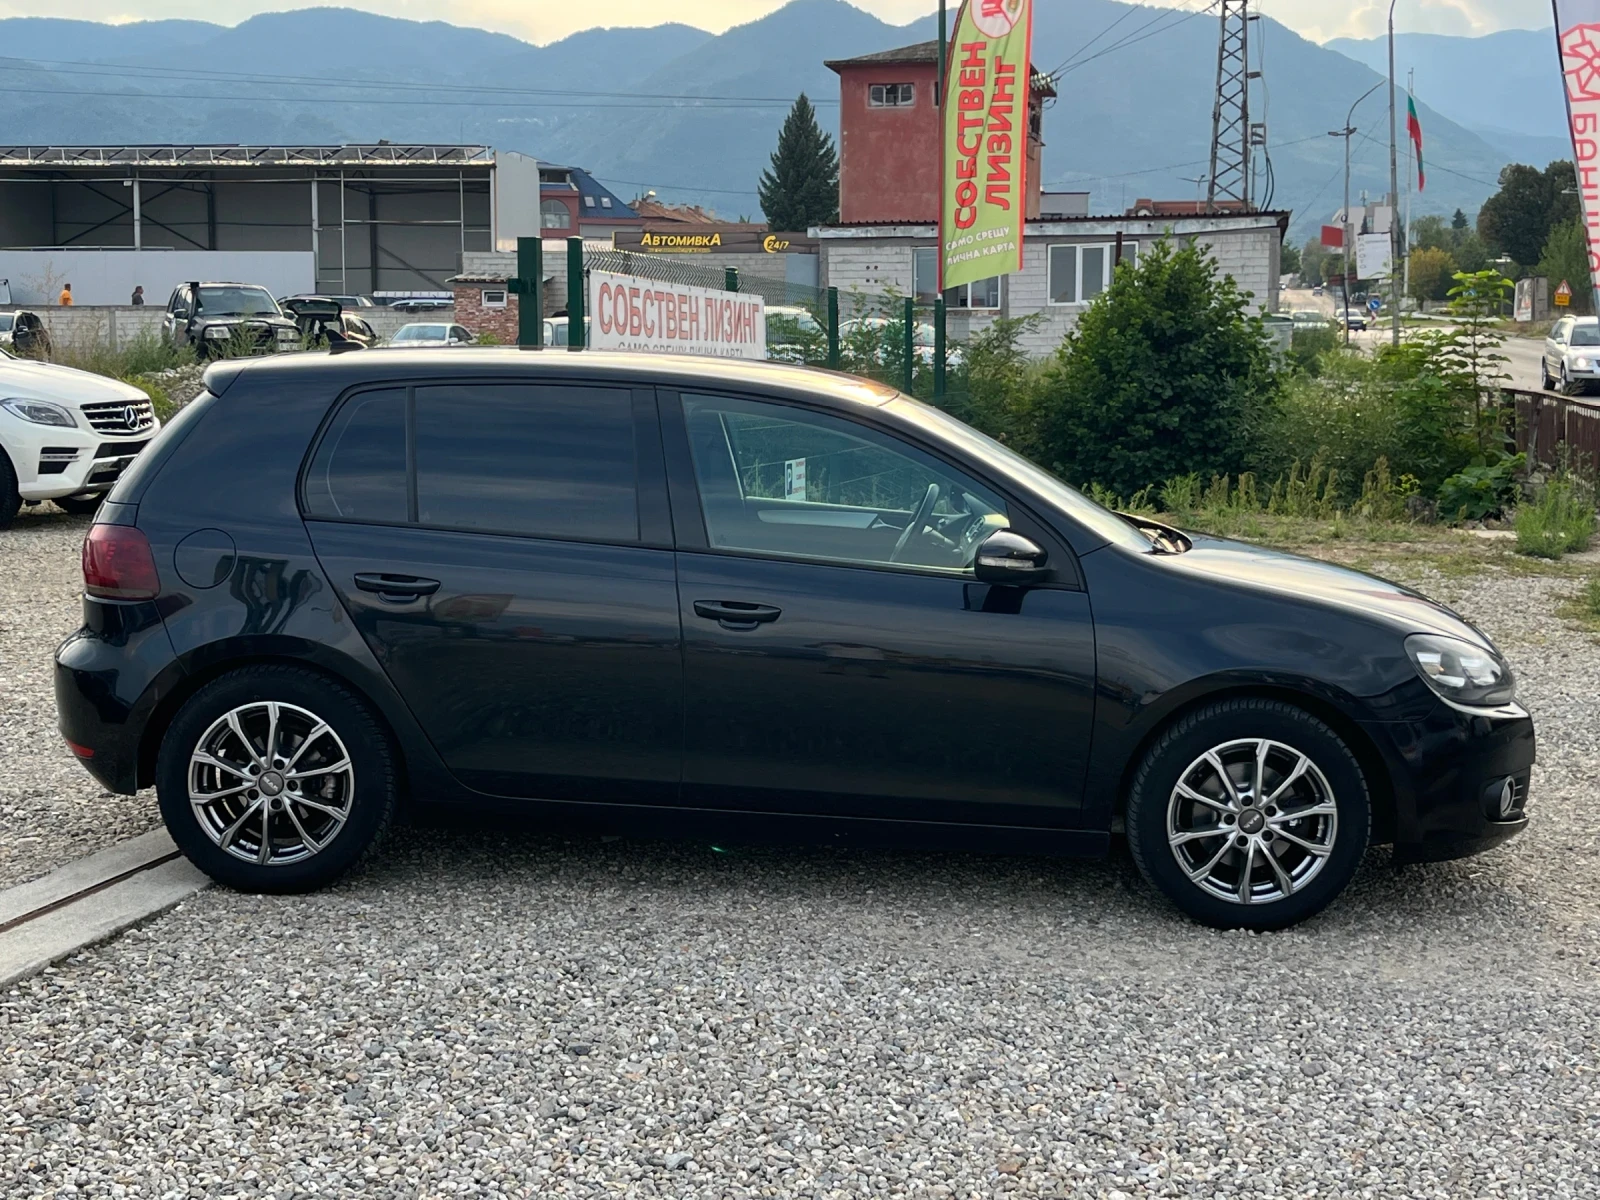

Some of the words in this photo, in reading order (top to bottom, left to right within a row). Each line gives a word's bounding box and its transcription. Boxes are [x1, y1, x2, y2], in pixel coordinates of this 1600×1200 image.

[954, 41, 987, 230] СОБСТВЕН
[984, 55, 1017, 211] ЛИЗИНГ
[768, 240, 790, 251] 24/7
[945, 235, 974, 251] САМО
[975, 226, 1010, 242] СРЕЩУ
[947, 249, 981, 266] ЛИЧНА
[982, 241, 1016, 256] КАРТА
[598, 282, 700, 341] СОБСТВЕН
[703, 299, 760, 344] ЛИЗИНГ
